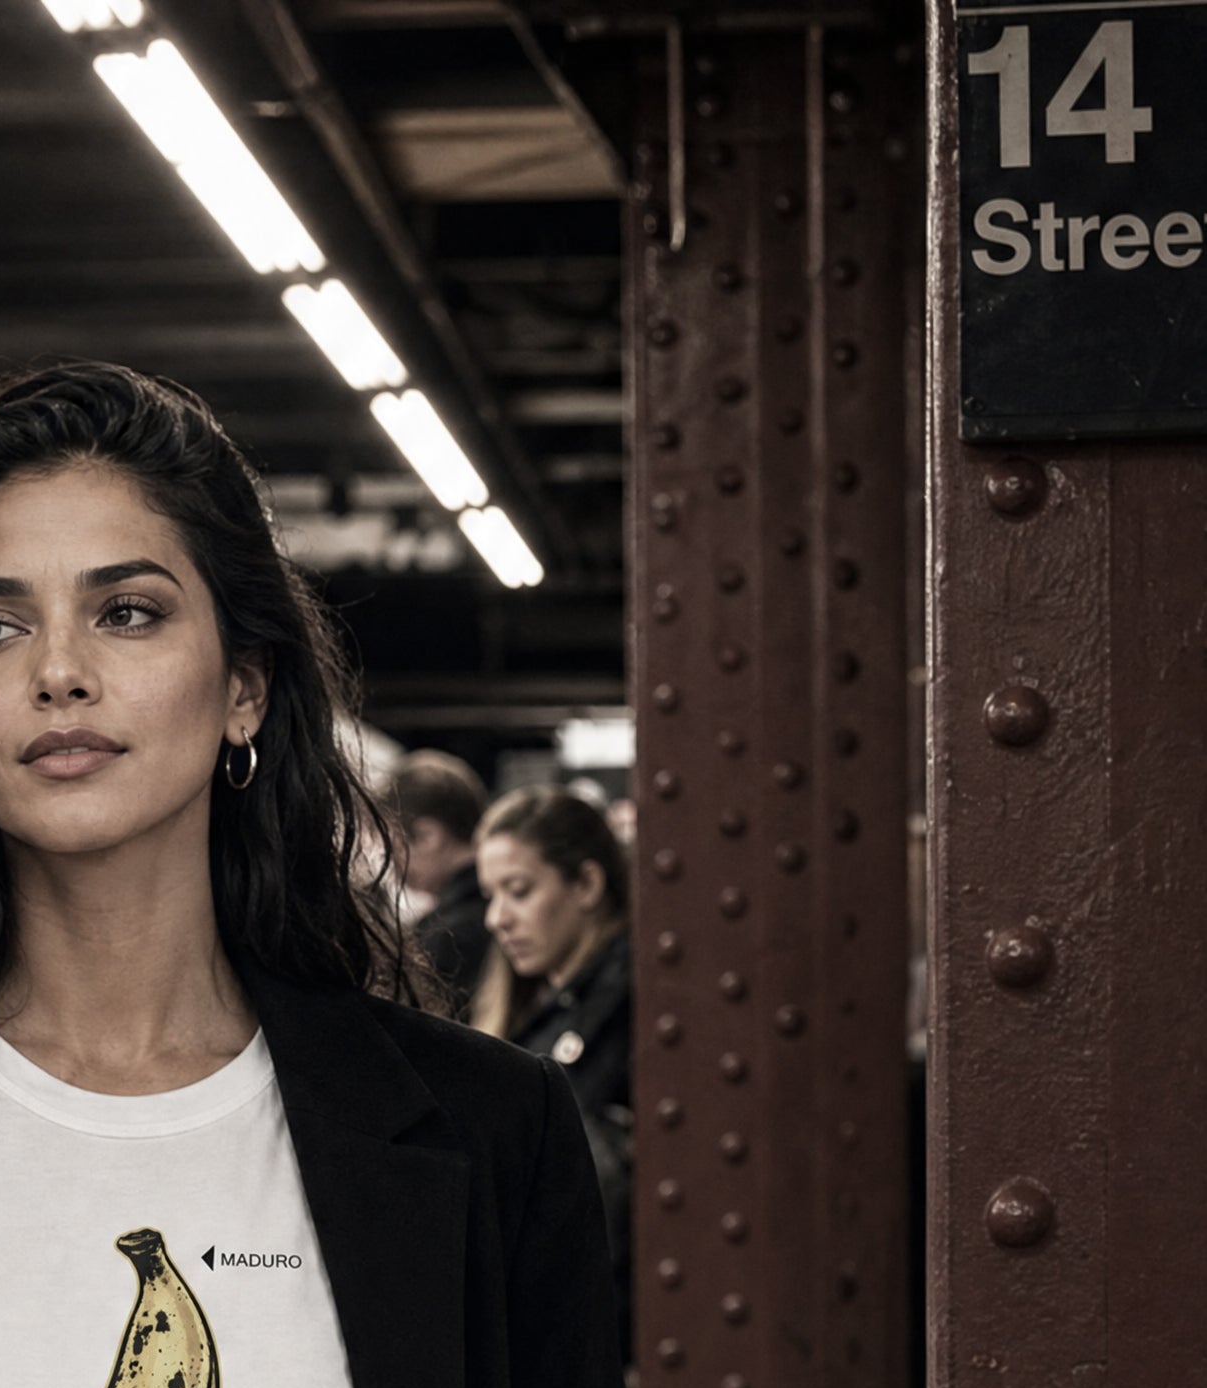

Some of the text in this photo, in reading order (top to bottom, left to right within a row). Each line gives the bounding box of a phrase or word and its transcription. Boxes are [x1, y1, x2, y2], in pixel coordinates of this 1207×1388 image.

[967, 20, 1153, 168] 14
[971, 198, 1207, 276] Stree
[220, 1252, 303, 1270] MADURO
